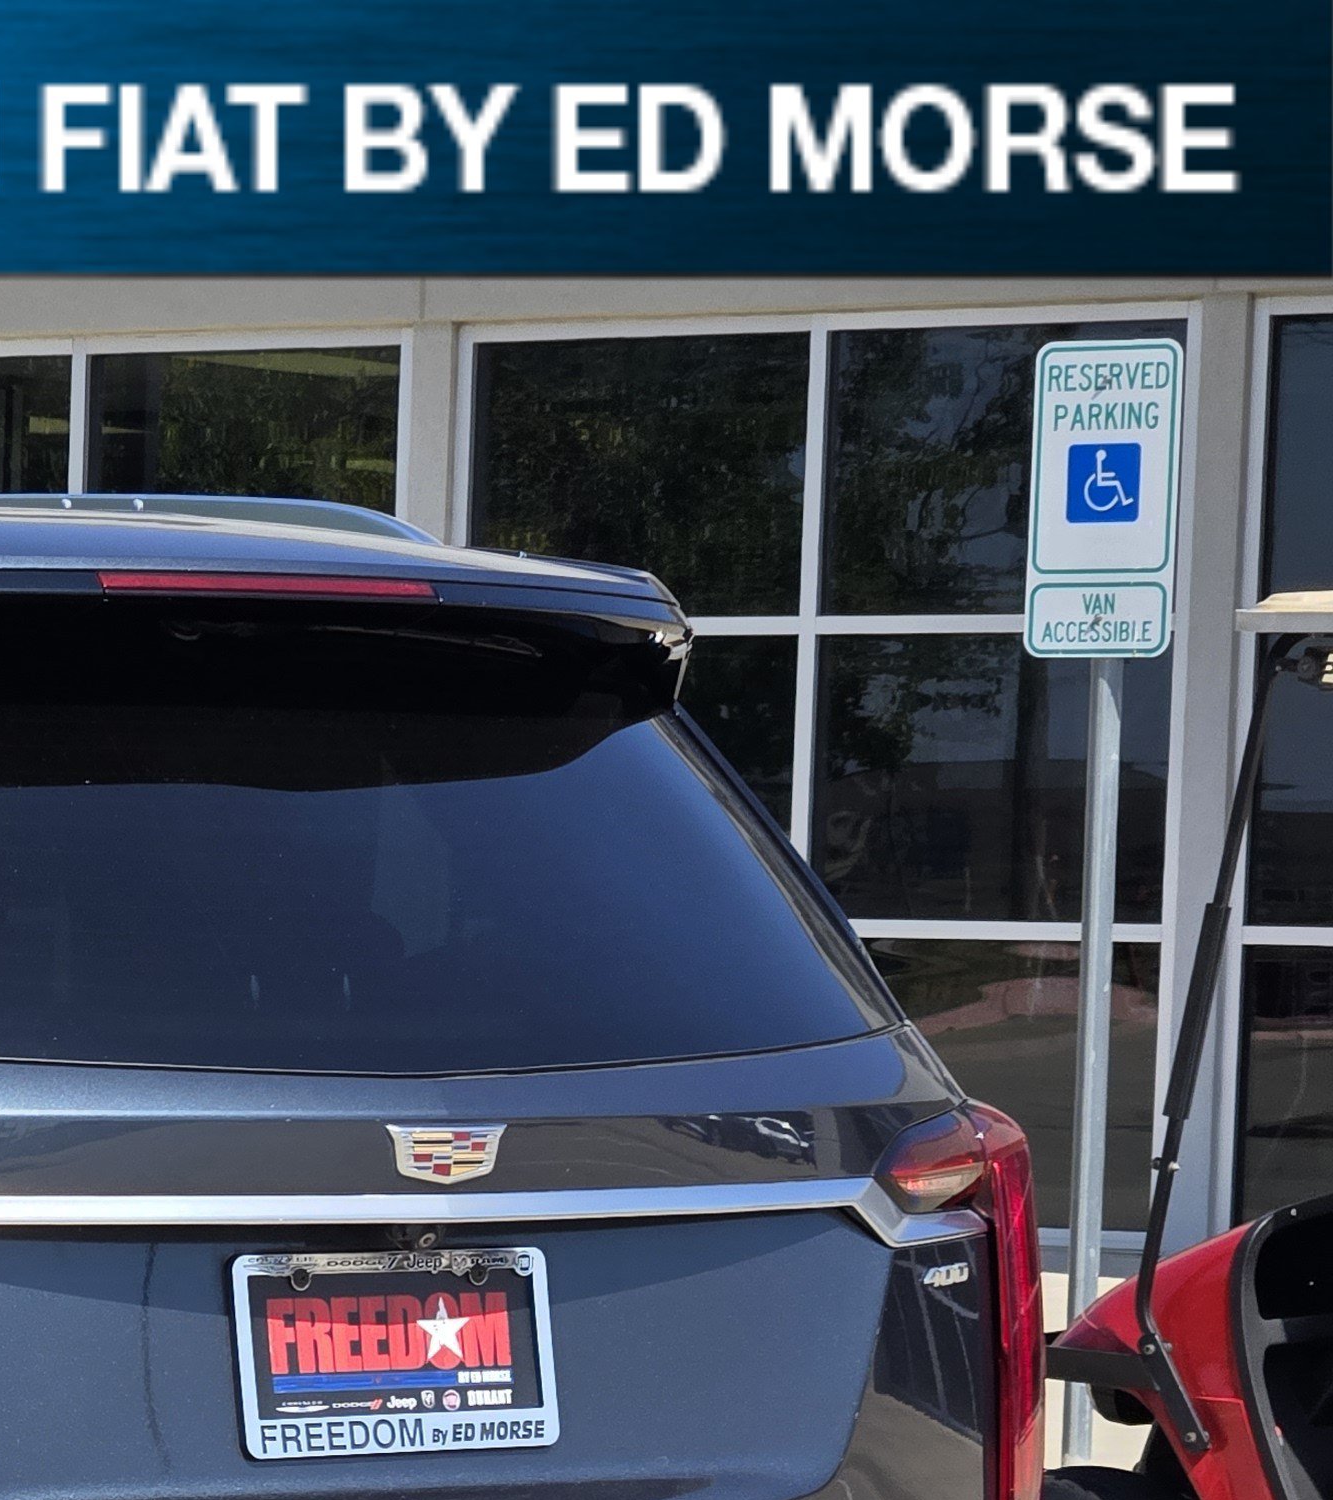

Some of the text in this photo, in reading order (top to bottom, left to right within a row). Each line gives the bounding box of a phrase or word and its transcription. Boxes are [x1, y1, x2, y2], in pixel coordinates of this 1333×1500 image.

[1047, 361, 1170, 392] RESERVED
[1053, 402, 1159, 432] PARKING
[1082, 593, 1115, 615] VAN
[1041, 620, 1152, 643] ACCESSIBLE
[266, 1292, 512, 1374] FREEDOM
[386, 1395, 417, 1410] Jeep
[260, 1418, 425, 1454] FREEDOM
[451, 1423, 476, 1442] ED
[480, 1419, 545, 1441] MORSE
